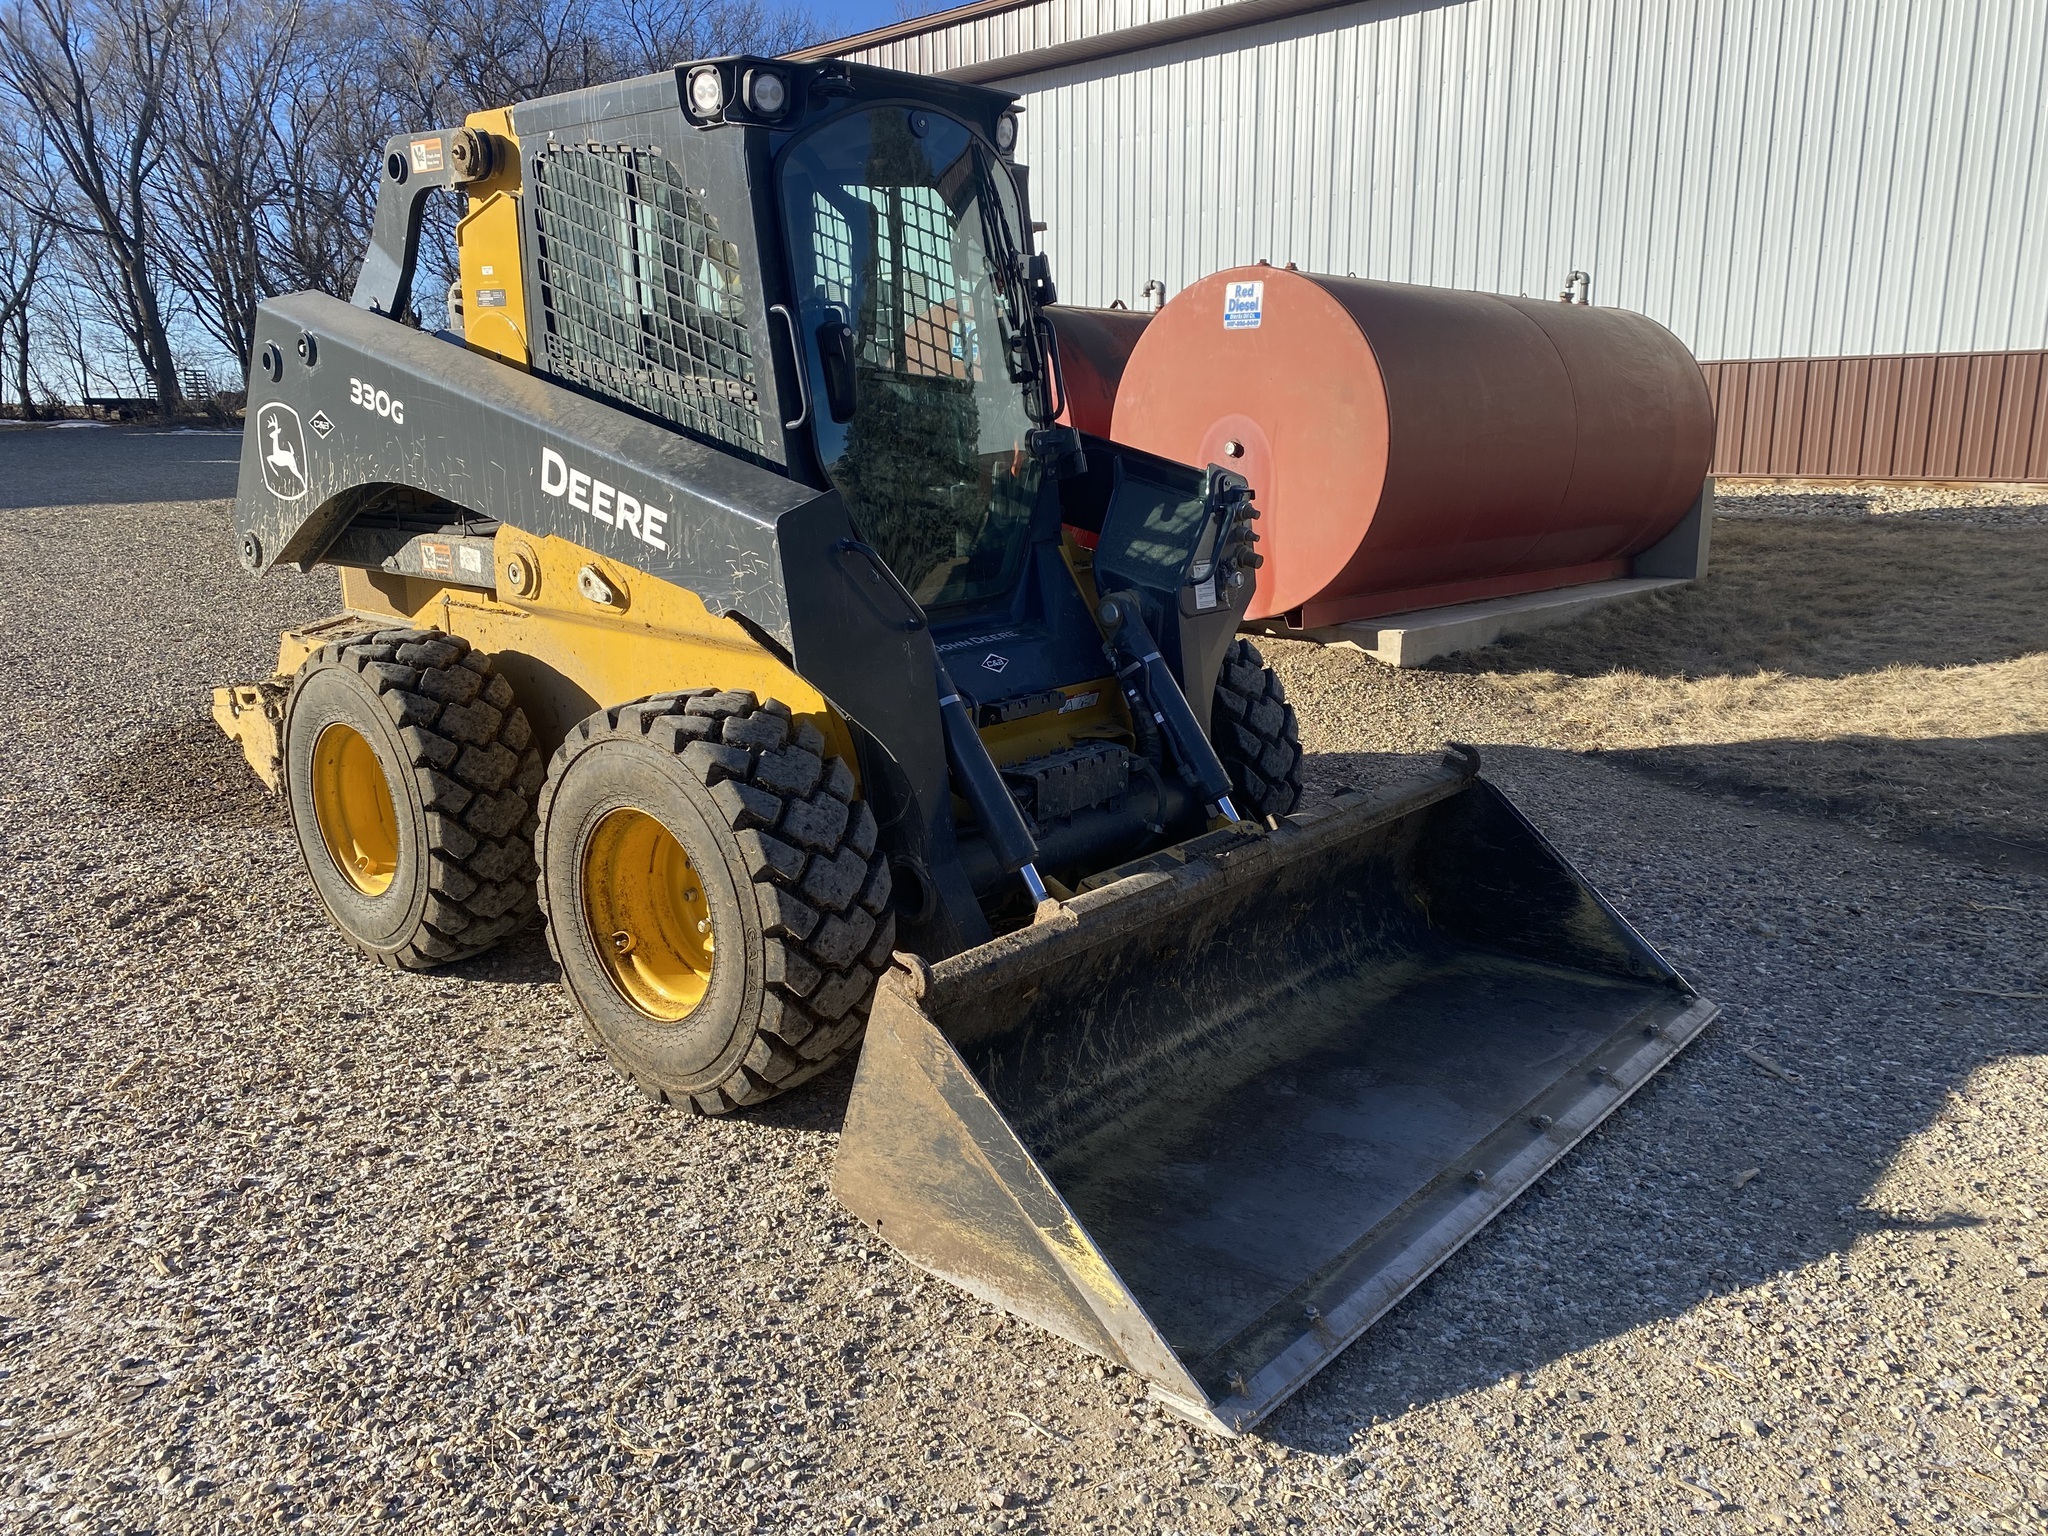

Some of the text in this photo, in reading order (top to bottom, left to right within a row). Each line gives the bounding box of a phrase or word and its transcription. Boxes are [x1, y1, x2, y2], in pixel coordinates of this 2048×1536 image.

[1235, 283, 1255, 298] Red
[1228, 296, 1259, 312] Diesel
[350, 377, 404, 425] 330G
[541, 446, 668, 551] DEERE
[935, 630, 1019, 653] JOHN DEERE
